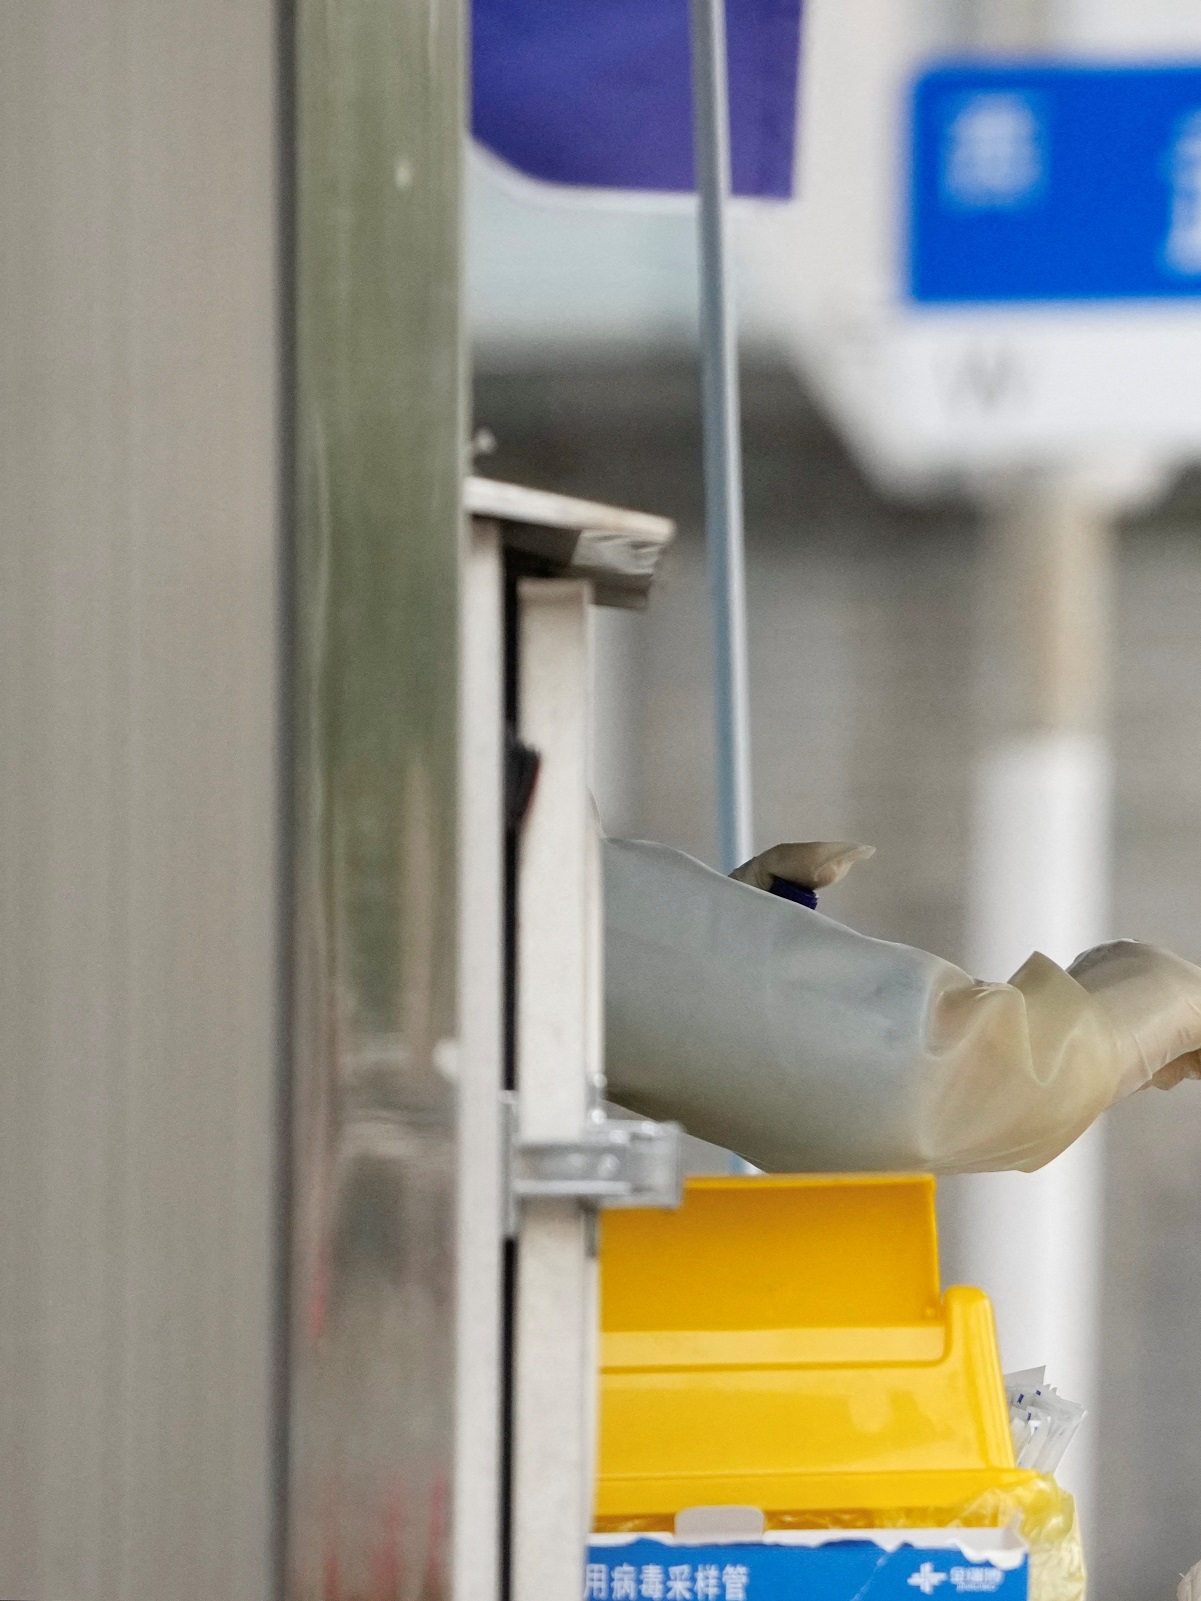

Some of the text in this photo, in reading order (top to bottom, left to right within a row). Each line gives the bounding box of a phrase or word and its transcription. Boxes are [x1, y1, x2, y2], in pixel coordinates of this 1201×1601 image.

[584, 1563, 751, 1601] 用病毒采样管
